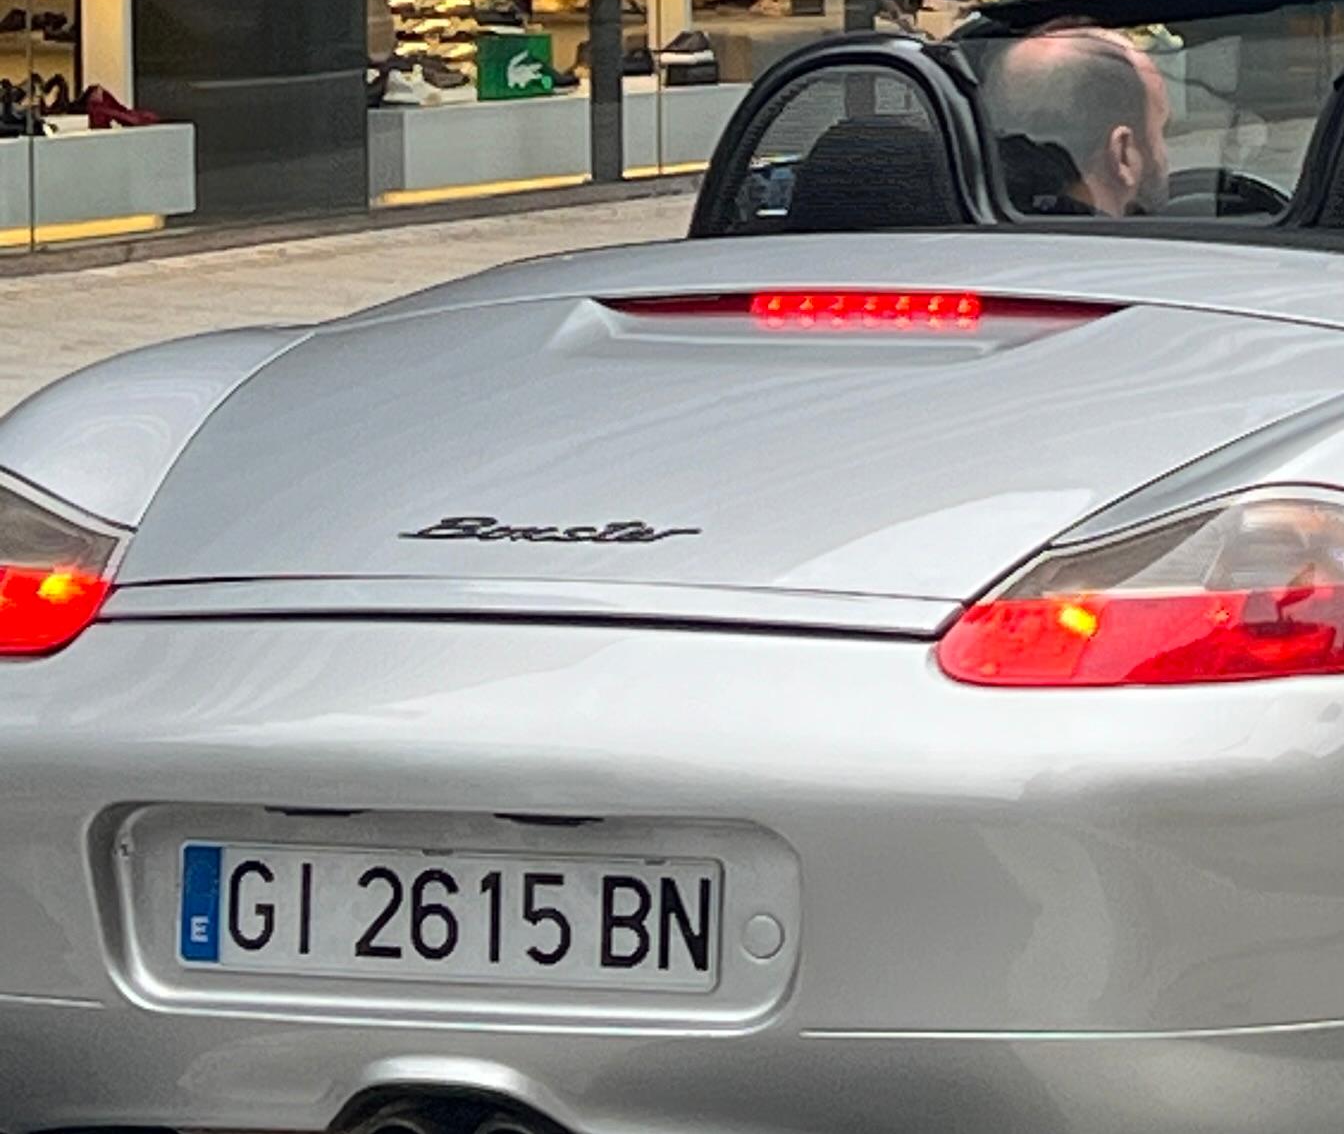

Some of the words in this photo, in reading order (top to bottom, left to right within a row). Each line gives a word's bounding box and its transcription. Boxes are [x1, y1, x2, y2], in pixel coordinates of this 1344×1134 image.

[398, 516, 702, 542] Boxster
[228, 860, 313, 955] GI
[354, 866, 572, 966] 2615
[600, 875, 712, 972] BN
